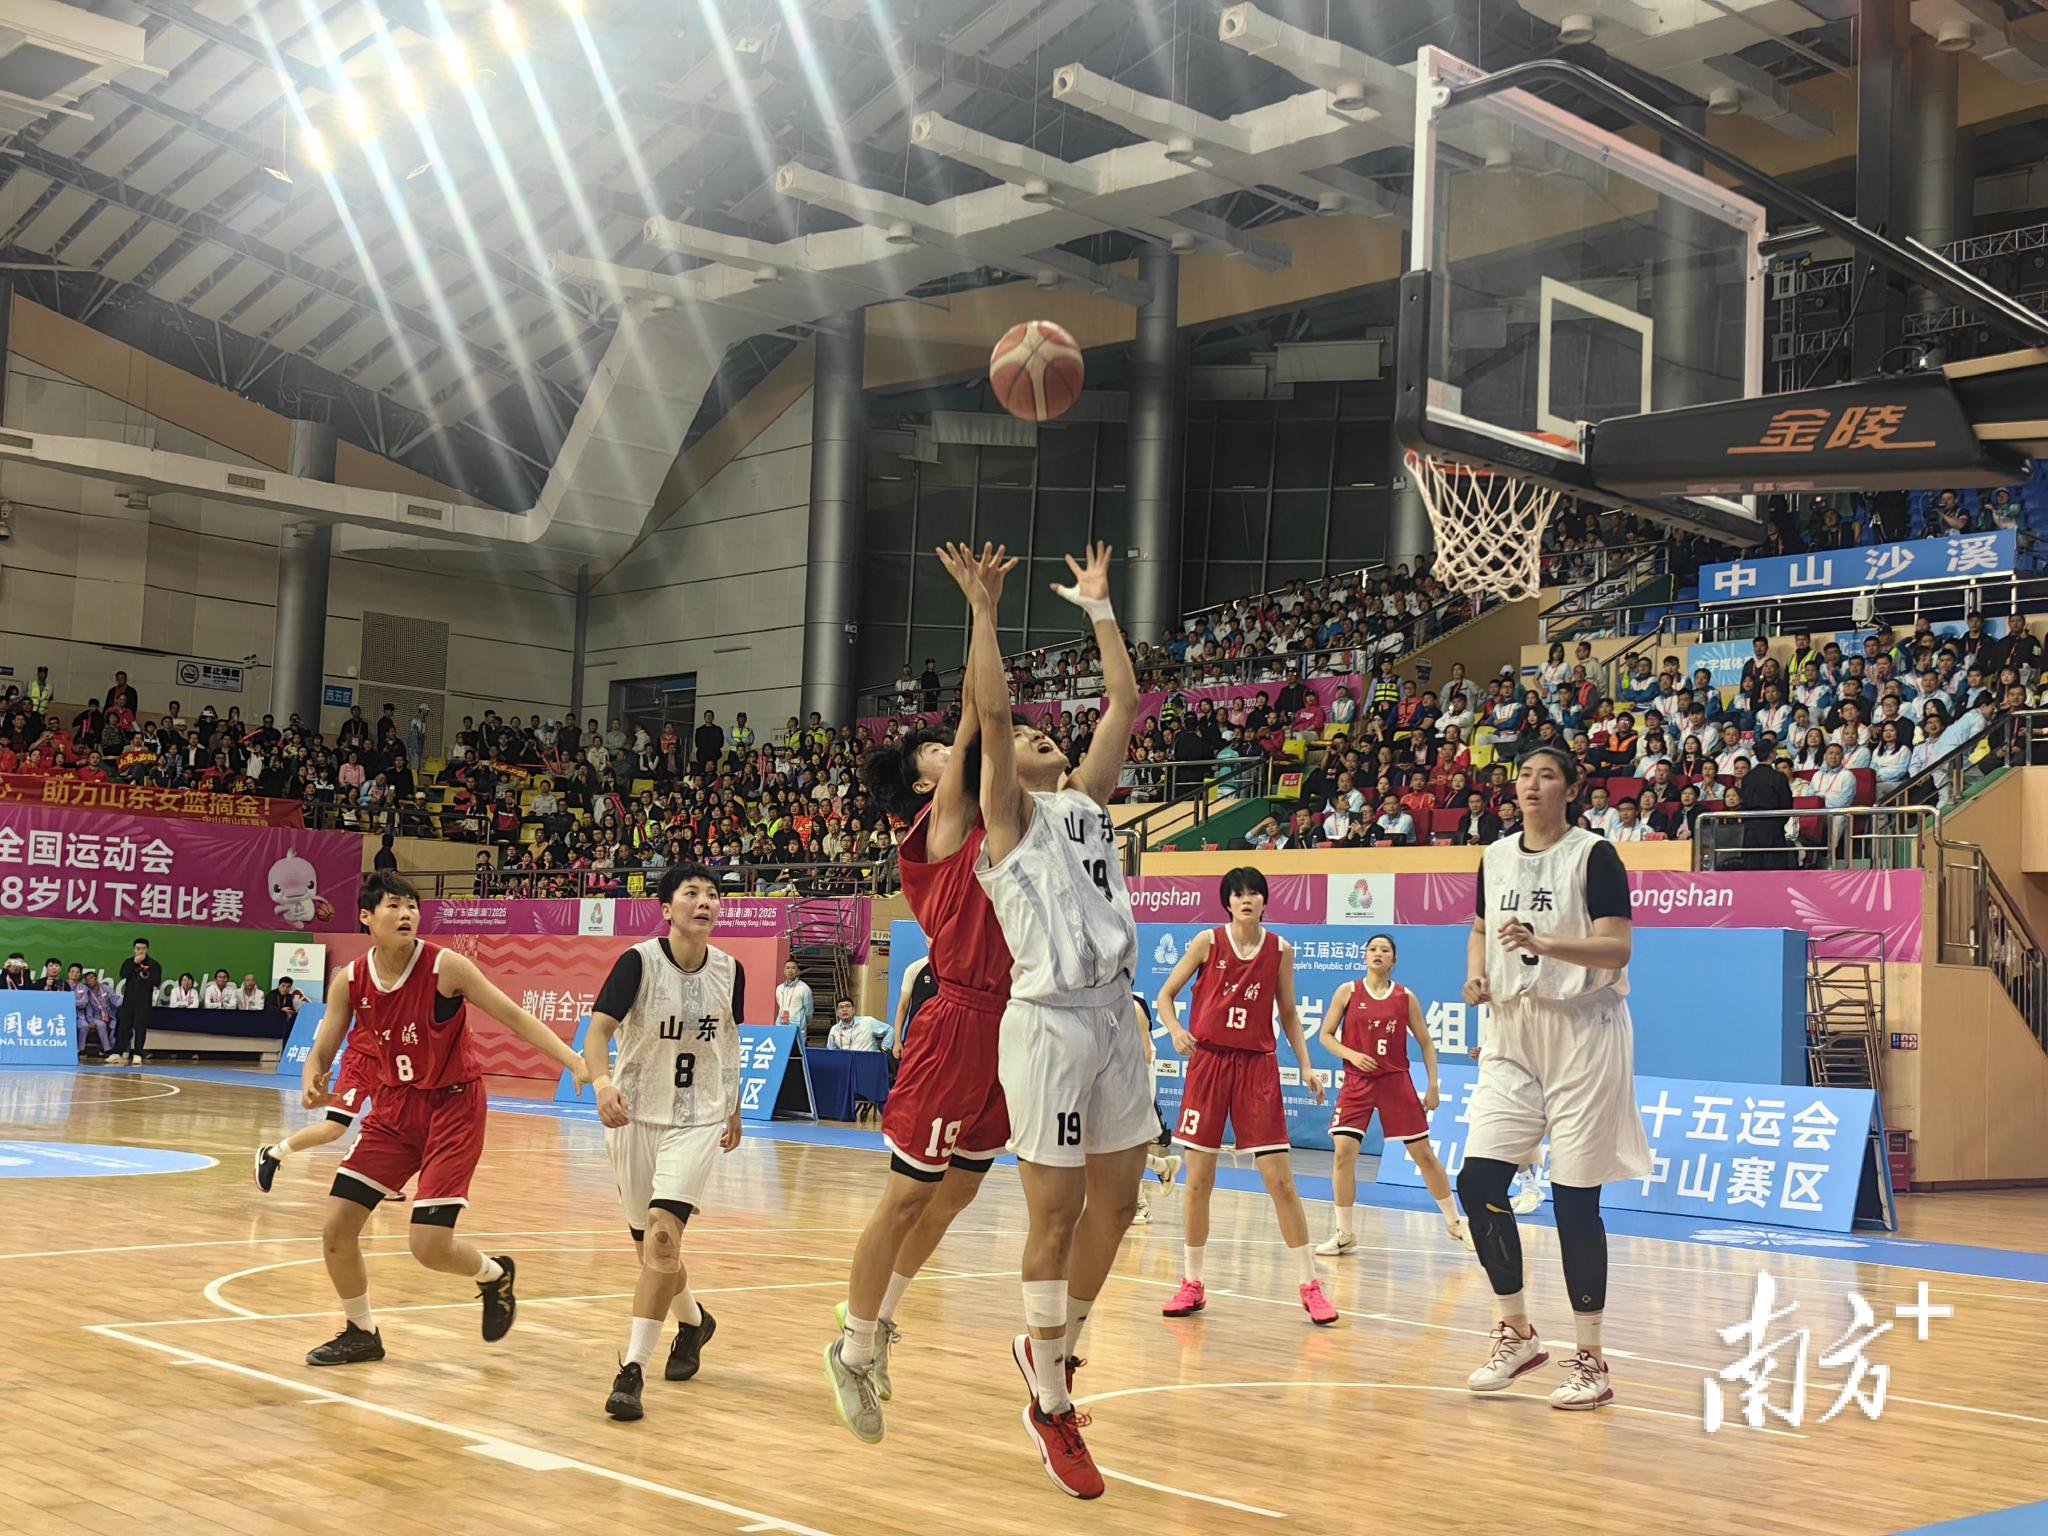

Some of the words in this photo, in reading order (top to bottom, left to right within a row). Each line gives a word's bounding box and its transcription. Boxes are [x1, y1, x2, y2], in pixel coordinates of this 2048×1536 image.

[1727, 404, 1937, 455] 金陵
[1714, 535, 1998, 597] 中山沙溪
[0, 826, 174, 874] 全国运动会
[1501, 887, 1552, 912] 山东
[660, 1015, 719, 1042] 山东
[1226, 1006, 1248, 1030] 13
[18, 1038, 67, 1047] TELECOM
[1376, 1039, 1388, 1056] 6
[396, 1054, 414, 1082] 8
[674, 1053, 696, 1088] 8
[342, 1088, 357, 1107] 4
[1057, 1111, 1082, 1146] 19
[1179, 1108, 1200, 1136] 13
[1640, 1090, 1839, 1151] 十五运会
[925, 1117, 962, 1158] 19
[1638, 1153, 1830, 1212] 中山赛区
